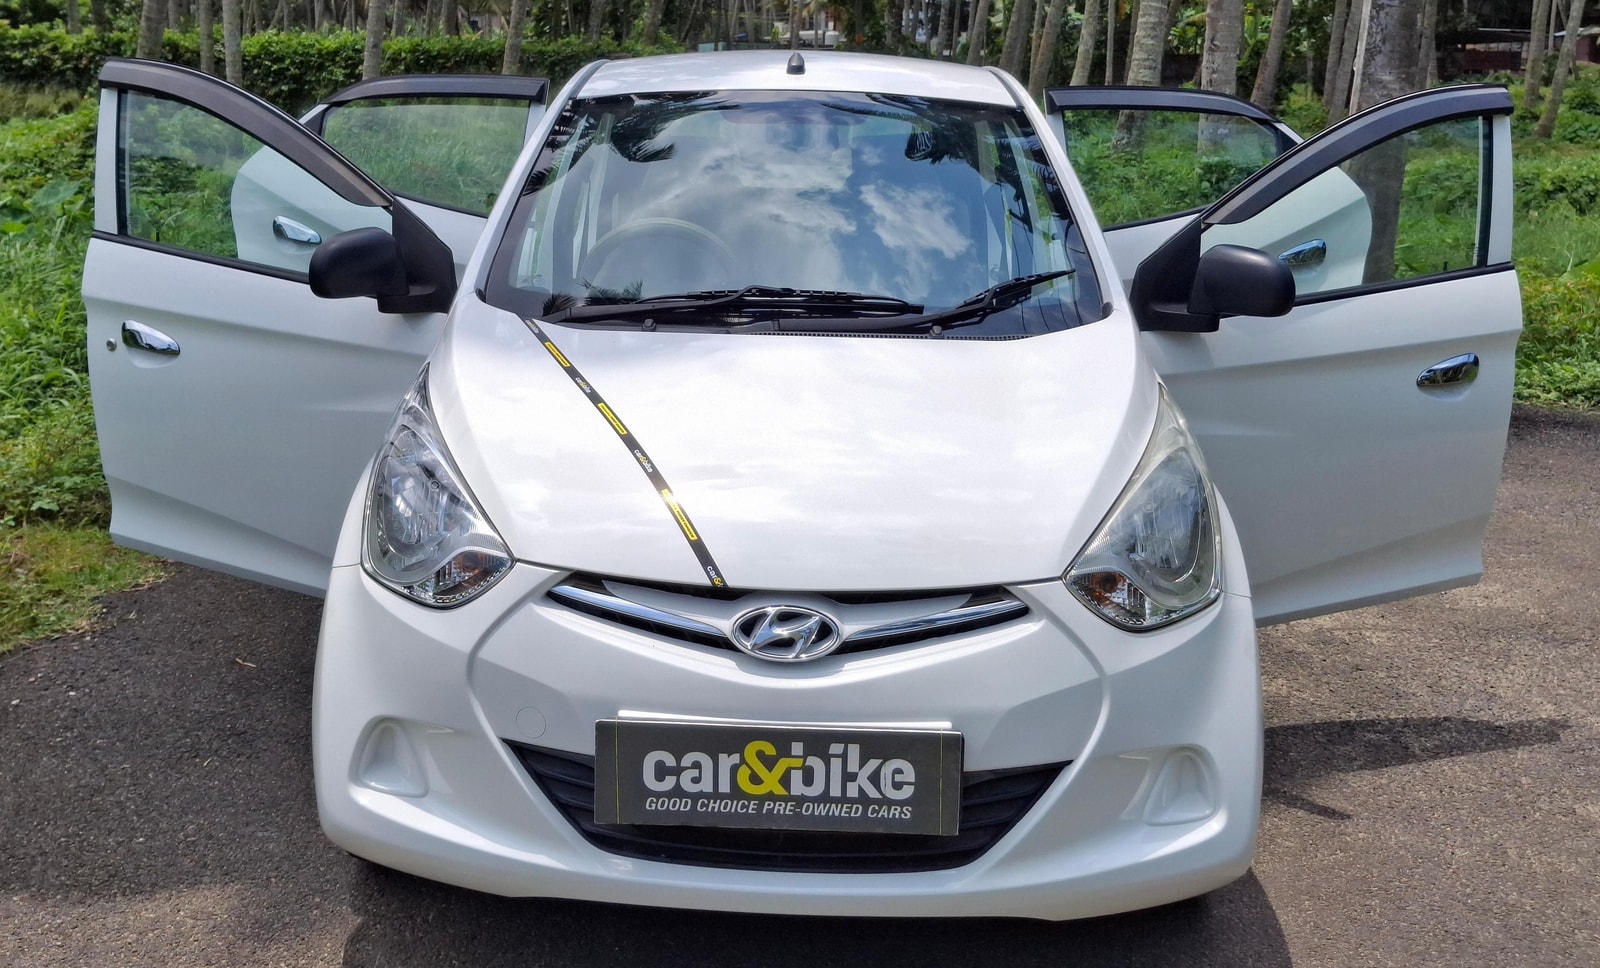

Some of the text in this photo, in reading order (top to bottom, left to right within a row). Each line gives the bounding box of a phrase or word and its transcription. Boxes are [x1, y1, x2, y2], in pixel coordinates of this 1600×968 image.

[642, 740, 916, 800] car&bike
[645, 797, 912, 820] GOOD CHOICE PRE-OWNED CARS
